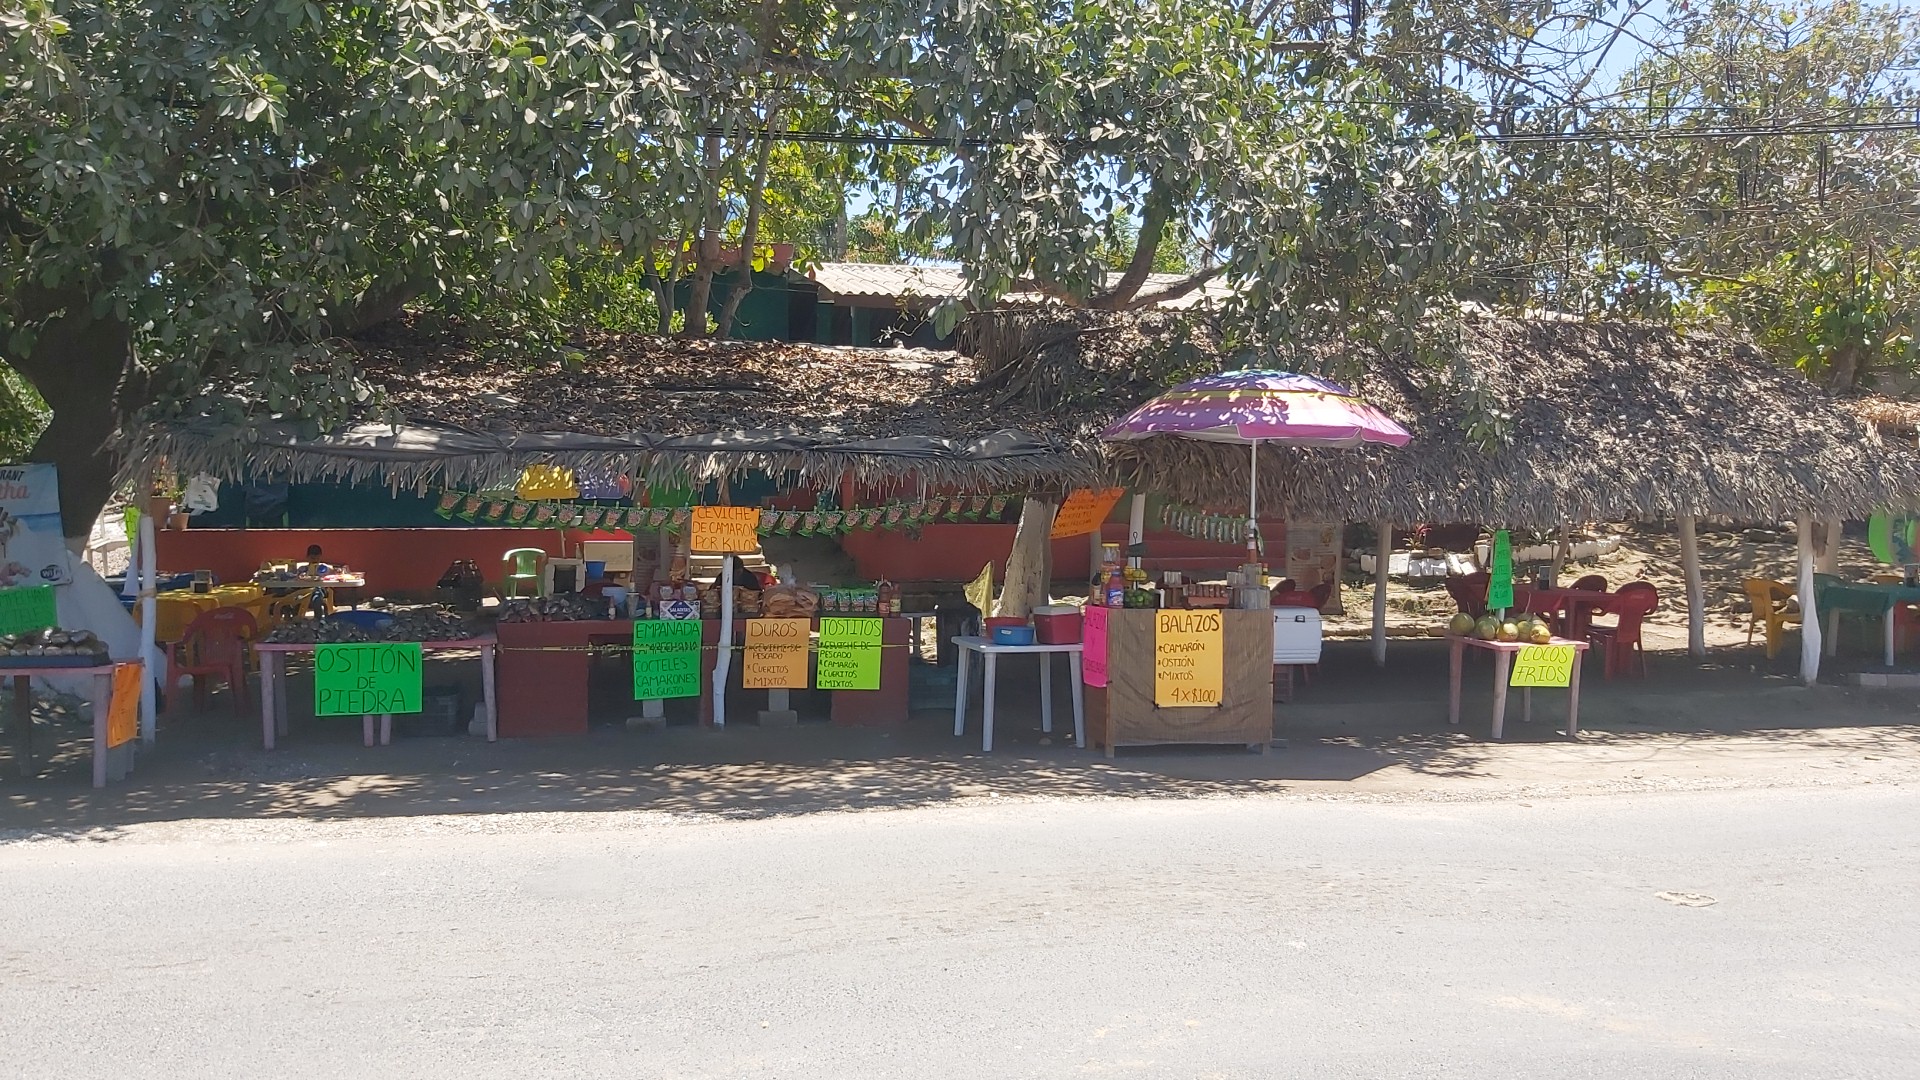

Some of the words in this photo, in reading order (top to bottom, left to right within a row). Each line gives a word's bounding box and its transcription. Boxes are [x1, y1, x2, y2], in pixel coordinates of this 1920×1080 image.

[697, 507, 751, 520] CEVICHE
[692, 521, 707, 533] DE
[695, 535, 718, 550] POR
[636, 622, 700, 638] EMPANADA
[750, 621, 798, 637] DUROS
[822, 619, 881, 637] TOSTITOS
[1160, 614, 1220, 633] BALAZOS
[861, 641, 871, 650] DE
[1163, 640, 1205, 653] CAMARÓN
[317, 643, 415, 674] OSTIÓN
[752, 652, 783, 660] PESCADO
[820, 650, 852, 658] PESCADO
[1523, 646, 1568, 664] COCOS
[634, 658, 688, 672] COCTELES
[1162, 655, 1195, 667] OSTIÓN
[752, 663, 789, 673] CUERITOS
[1517, 665, 1567, 683] FRIOS
[636, 673, 697, 687] CAMARONES
[753, 676, 787, 687] MIXTOS
[1162, 671, 1194, 680] MIXTOS
[357, 676, 376, 689] DE
[642, 687, 655, 697] AL
[656, 686, 684, 696] GUSTO
[319, 688, 406, 715] PIEDRA
